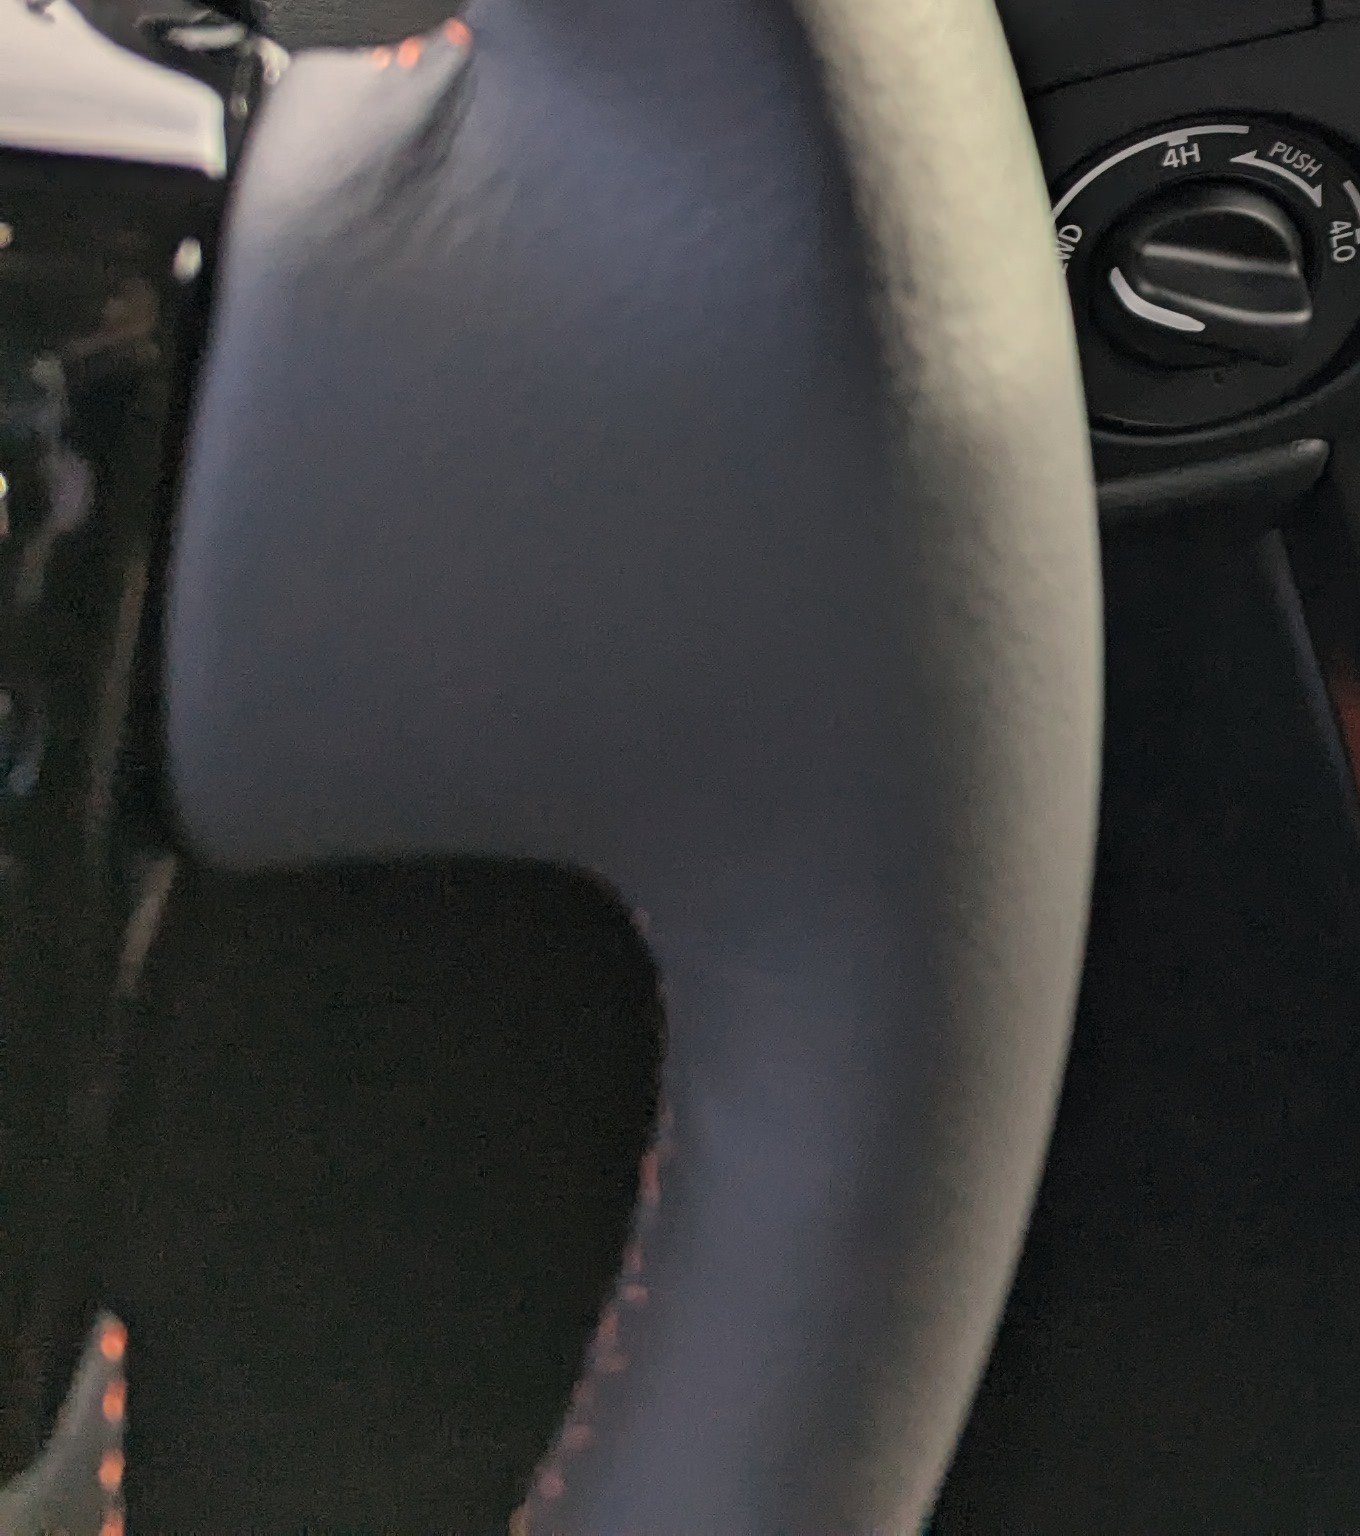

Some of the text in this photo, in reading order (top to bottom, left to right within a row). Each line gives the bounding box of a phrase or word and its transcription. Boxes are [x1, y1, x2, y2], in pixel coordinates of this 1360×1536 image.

[1162, 142, 1201, 168] 4H
[1270, 141, 1323, 177] PUSH
[1330, 219, 1356, 263] 4LO
